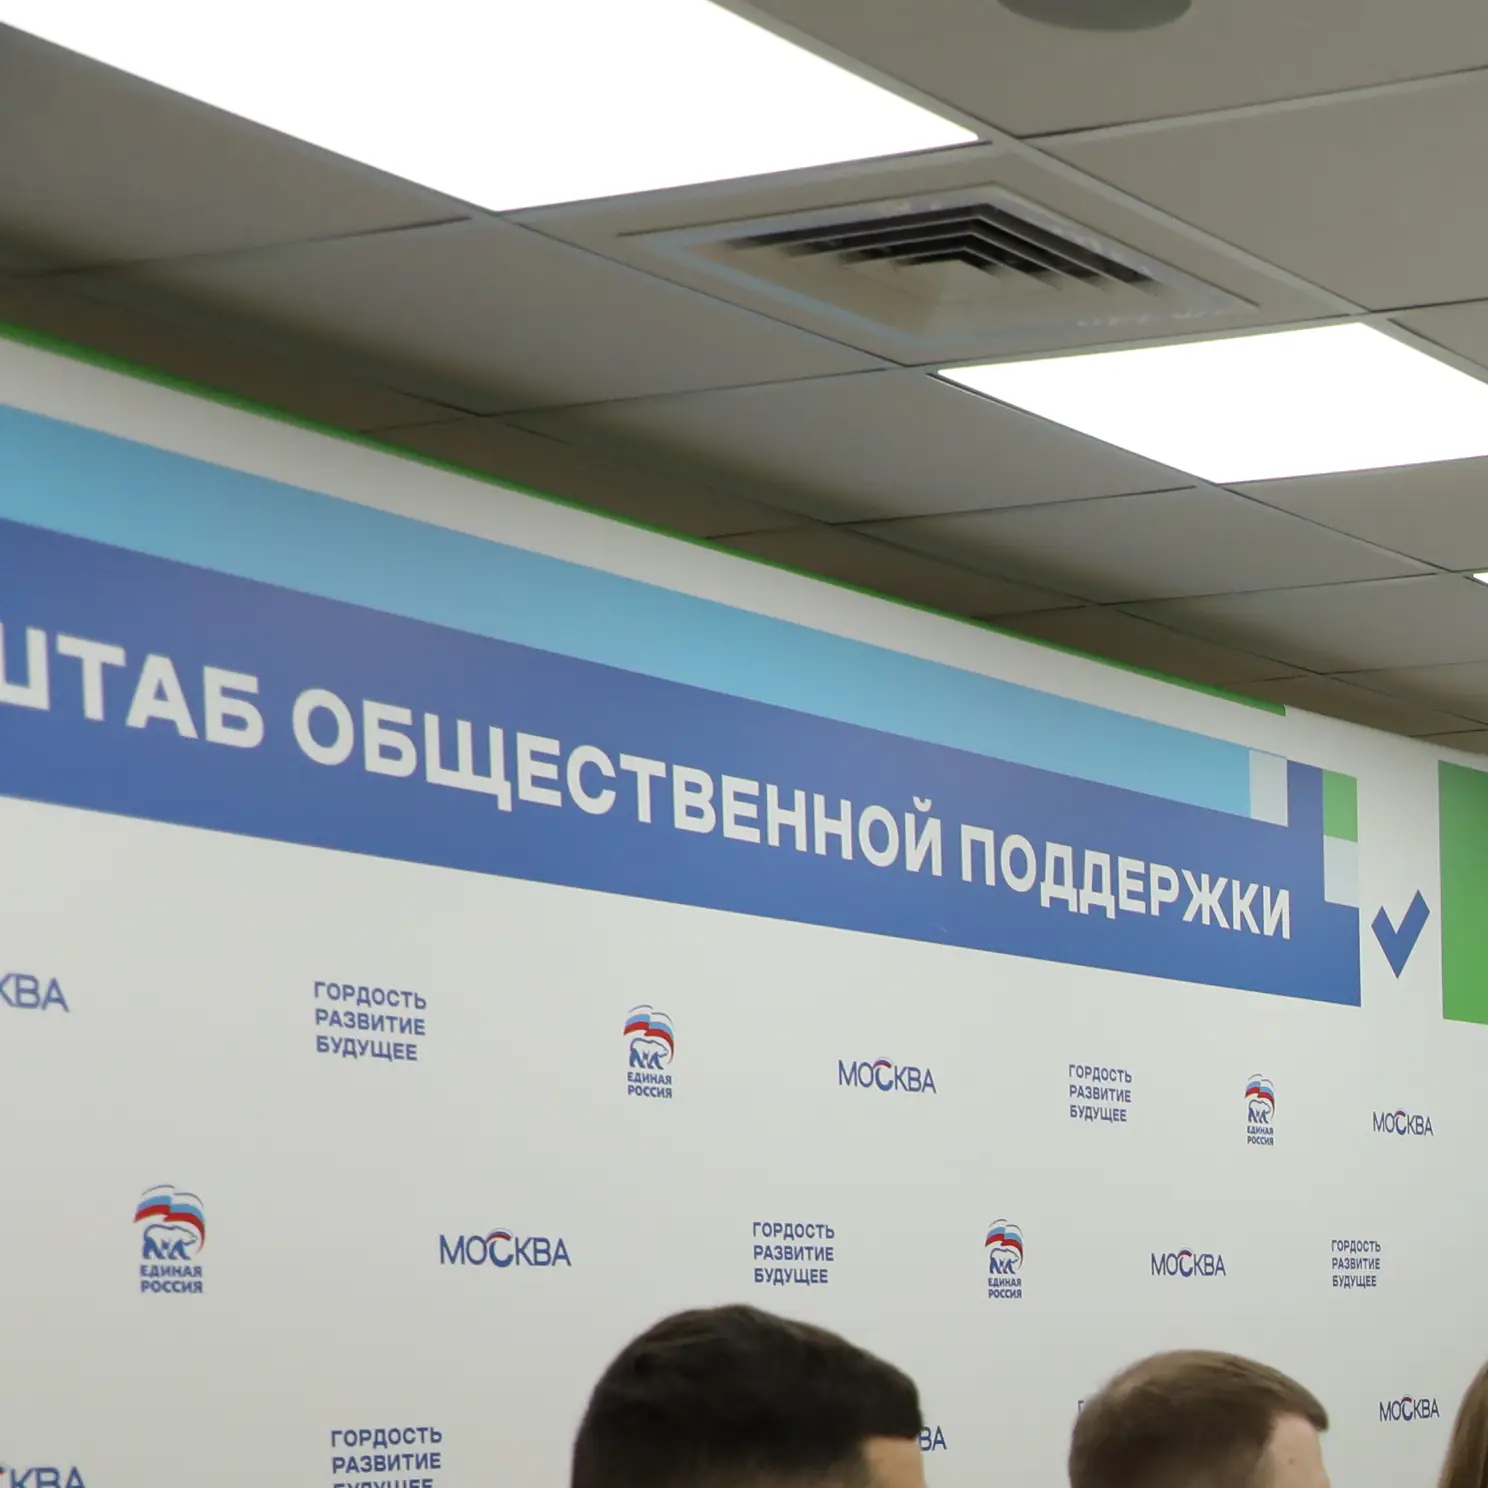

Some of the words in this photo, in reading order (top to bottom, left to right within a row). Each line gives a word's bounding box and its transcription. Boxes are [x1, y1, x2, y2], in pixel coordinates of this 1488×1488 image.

[0, 622, 265, 749] ШТАБ
[292, 688, 943, 876] ОБЩЕСТВЕННОЙ
[961, 824, 1291, 940] ПОДДЕРЖКИ
[314, 982, 426, 1010] ГОРДОСТЬ
[314, 1008, 425, 1036] РАЗВИТИЕ
[316, 1035, 418, 1062] БУДУЩЕЕ
[627, 1072, 672, 1086] ЕДИНАЯ
[838, 1057, 937, 1095] МОСКВА
[1068, 1064, 1132, 1085] ГОРДОСТЬ
[627, 1085, 673, 1099] РОССИЯ
[1069, 1084, 1132, 1104] РАЗВИТИЕ
[1070, 1104, 1127, 1123] БУДУЩЕЕ
[1372, 1108, 1434, 1137] МОСКВА
[1246, 1125, 1274, 1136] ЕДИНАЯ
[1246, 1136, 1274, 1146] РОССИЯ
[752, 1222, 835, 1241] ГОРДОСТЬ
[439, 1228, 572, 1268] МОСКВА
[753, 1243, 835, 1262] РАЗВИТИЕ
[1331, 1239, 1381, 1255] ГОРДОСТЬ
[140, 1264, 203, 1280] ЕДИНАЯ
[1151, 1248, 1226, 1277] МОСКВА
[1331, 1256, 1381, 1272] РАЗВИТИЕ
[754, 1266, 829, 1287] БУДУЩЕЕ
[988, 1277, 1022, 1287] ЕДИНАЯ
[1332, 1273, 1377, 1289] БУДУЩЕЕ
[140, 1280, 203, 1293] РОССИЯ
[988, 1288, 1022, 1298] РОССИЯ
[1379, 1394, 1440, 1422] МОСКВА
[331, 1426, 443, 1450] ГОРДОСТЬ
[331, 1452, 442, 1475] РАЗВИТИЕ
